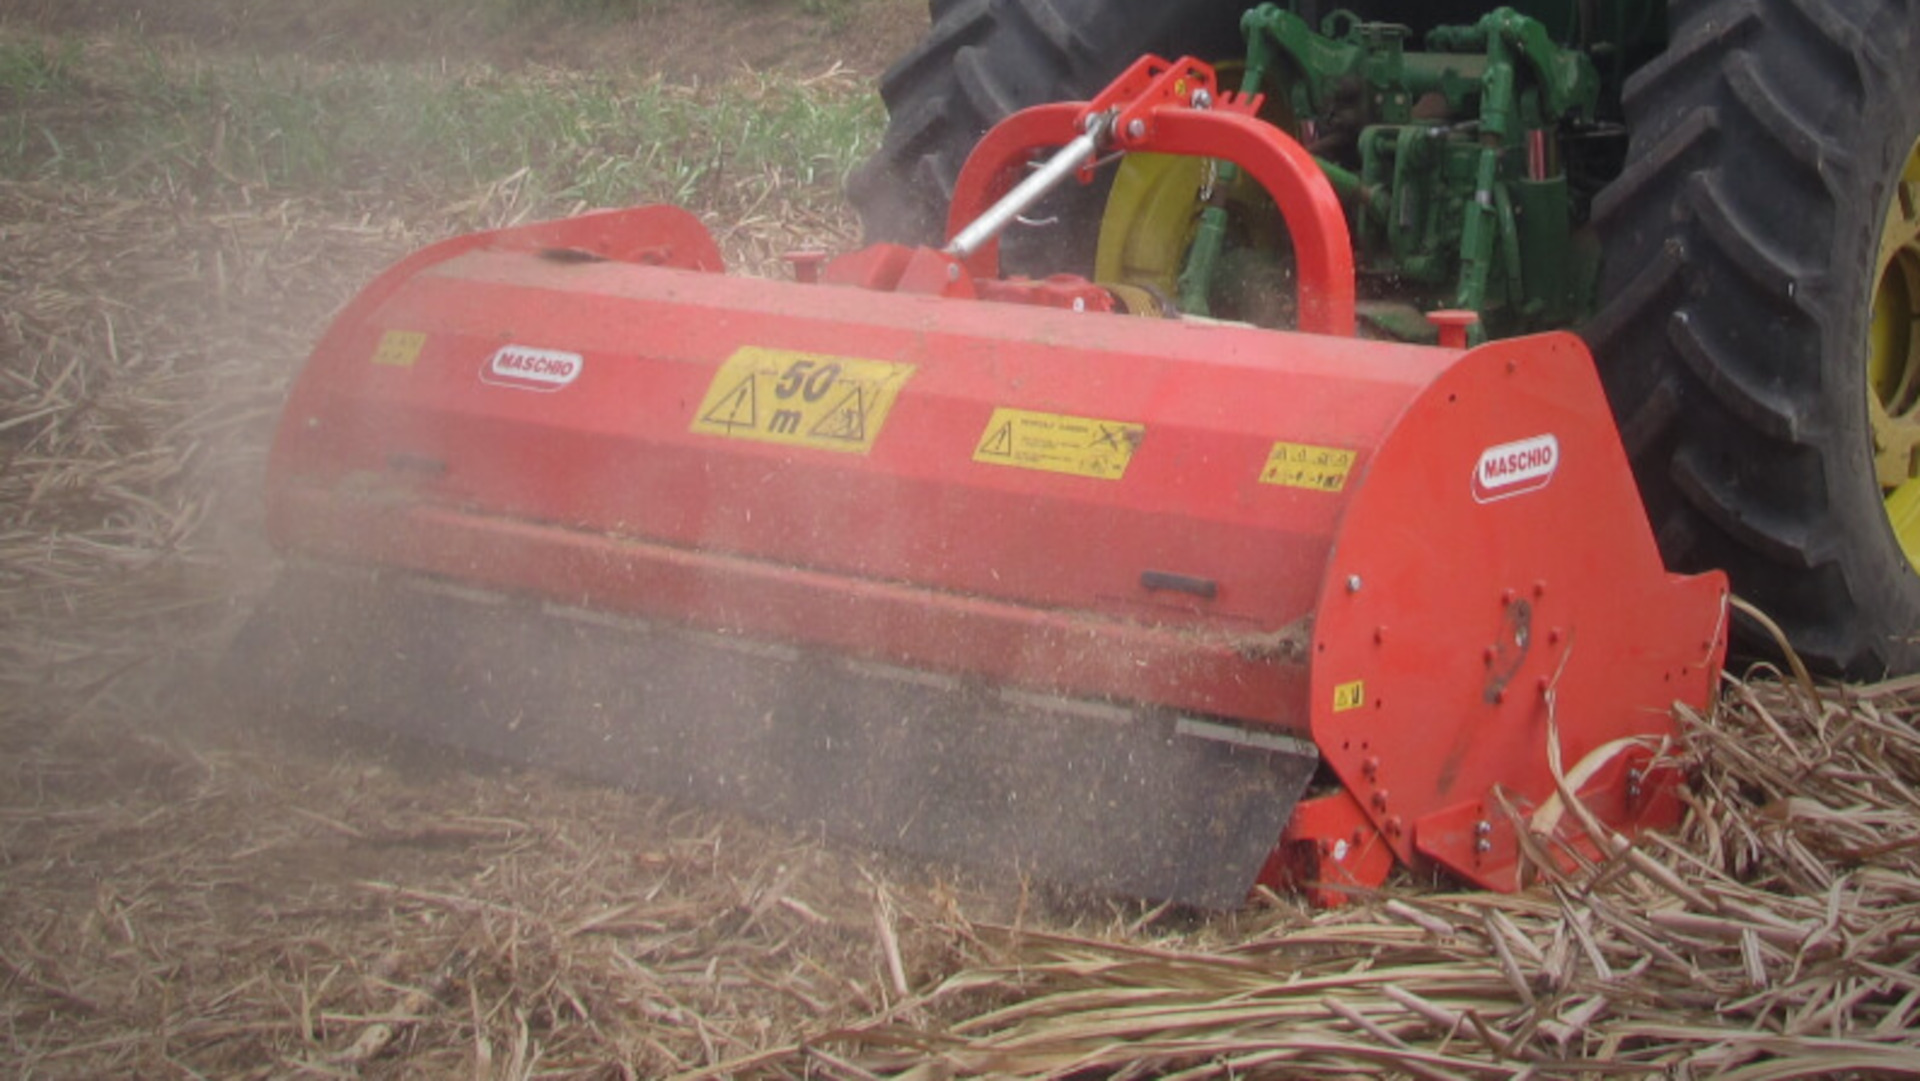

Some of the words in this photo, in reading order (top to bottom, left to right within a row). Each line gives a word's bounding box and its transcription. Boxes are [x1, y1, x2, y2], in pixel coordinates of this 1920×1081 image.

[497, 353, 575, 377] MASCHIO
[774, 360, 842, 403] 50
[768, 409, 803, 434] m
[1484, 445, 1552, 480] MASCHIO
